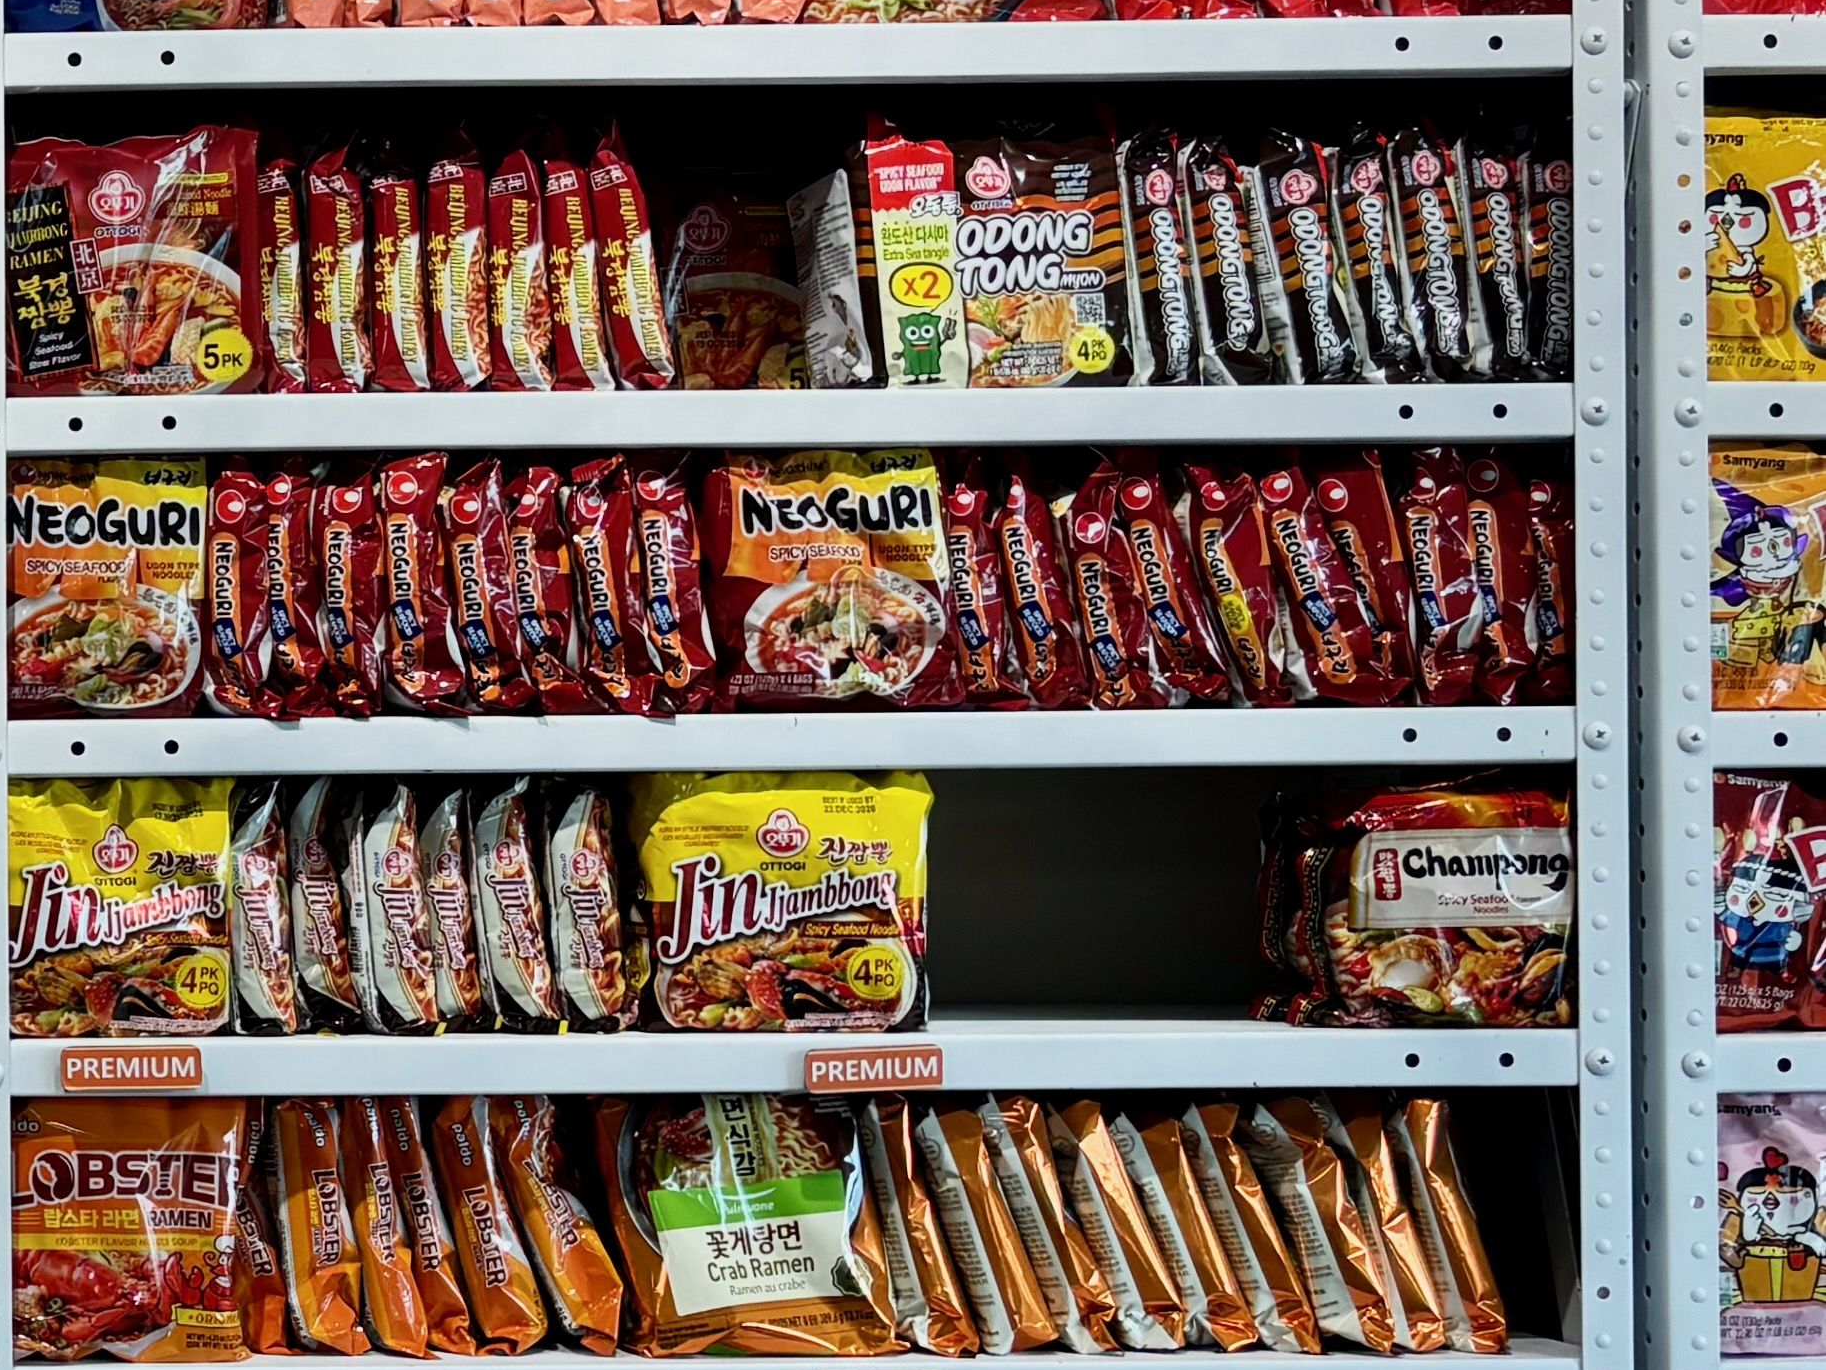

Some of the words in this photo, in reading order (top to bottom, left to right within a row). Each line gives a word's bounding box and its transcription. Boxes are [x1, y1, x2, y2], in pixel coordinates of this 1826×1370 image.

[955, 213, 1092, 255] ODONG
[957, 251, 1061, 294] TONG
[1059, 269, 1103, 288] MYON
[6, 500, 202, 550] NEOGURI
[25, 558, 64, 575] SPICY
[65, 558, 127, 575] SEAFOOD
[817, 834, 892, 865] 진짬뽕
[758, 859, 806, 873] OTTOGI
[1401, 846, 1571, 892] Champong
[64, 1054, 197, 1080] PREMIUM
[810, 1055, 939, 1083] PREMIUM
[44, 1208, 101, 1230] 랍스타
[103, 1208, 141, 1229] 라면
[148, 1207, 212, 1230] RAMEN
[705, 1220, 804, 1255] 꽃게탕면
[707, 1256, 755, 1283] Crab
[758, 1253, 815, 1278] Ramen
